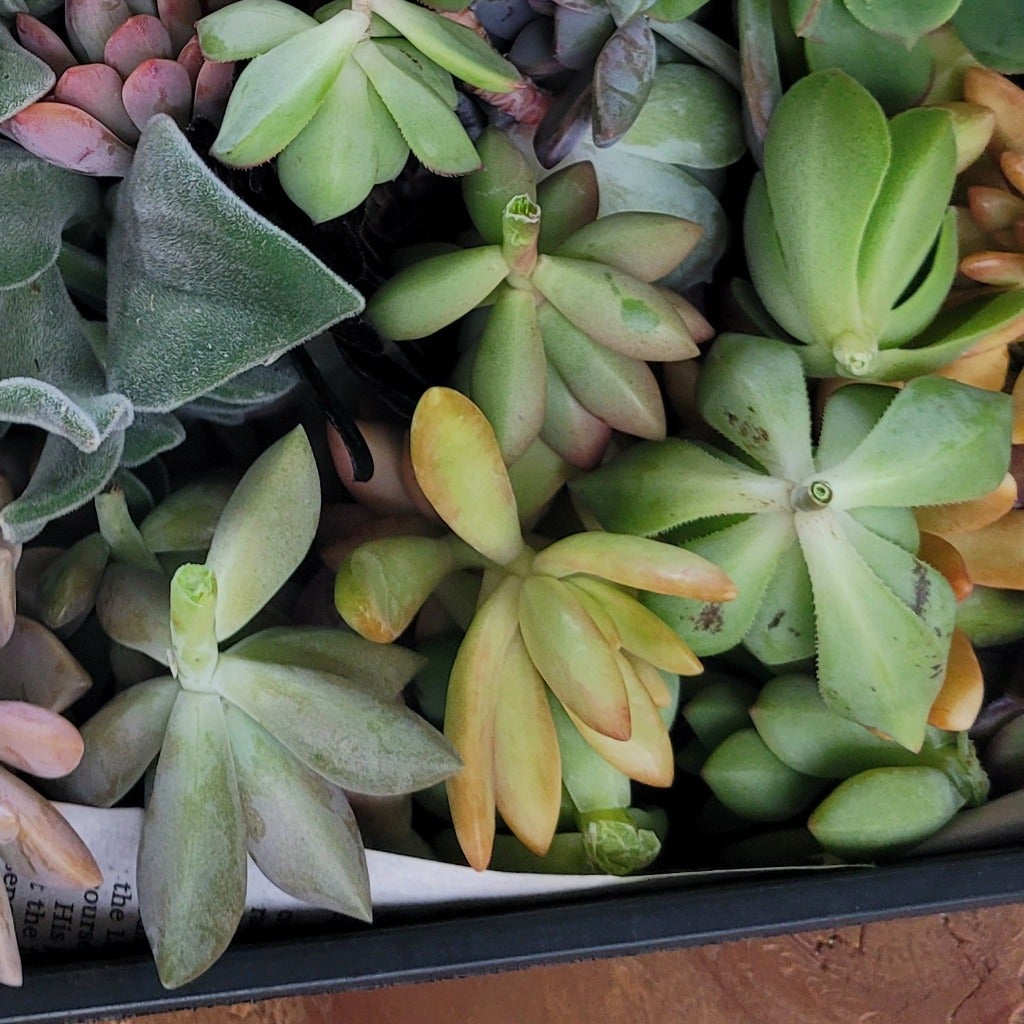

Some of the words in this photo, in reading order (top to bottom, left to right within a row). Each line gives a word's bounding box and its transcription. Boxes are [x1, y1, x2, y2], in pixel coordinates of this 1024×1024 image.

[22, 899, 46, 938] the
[50, 899, 74, 942] His
[109, 881, 133, 921] the
